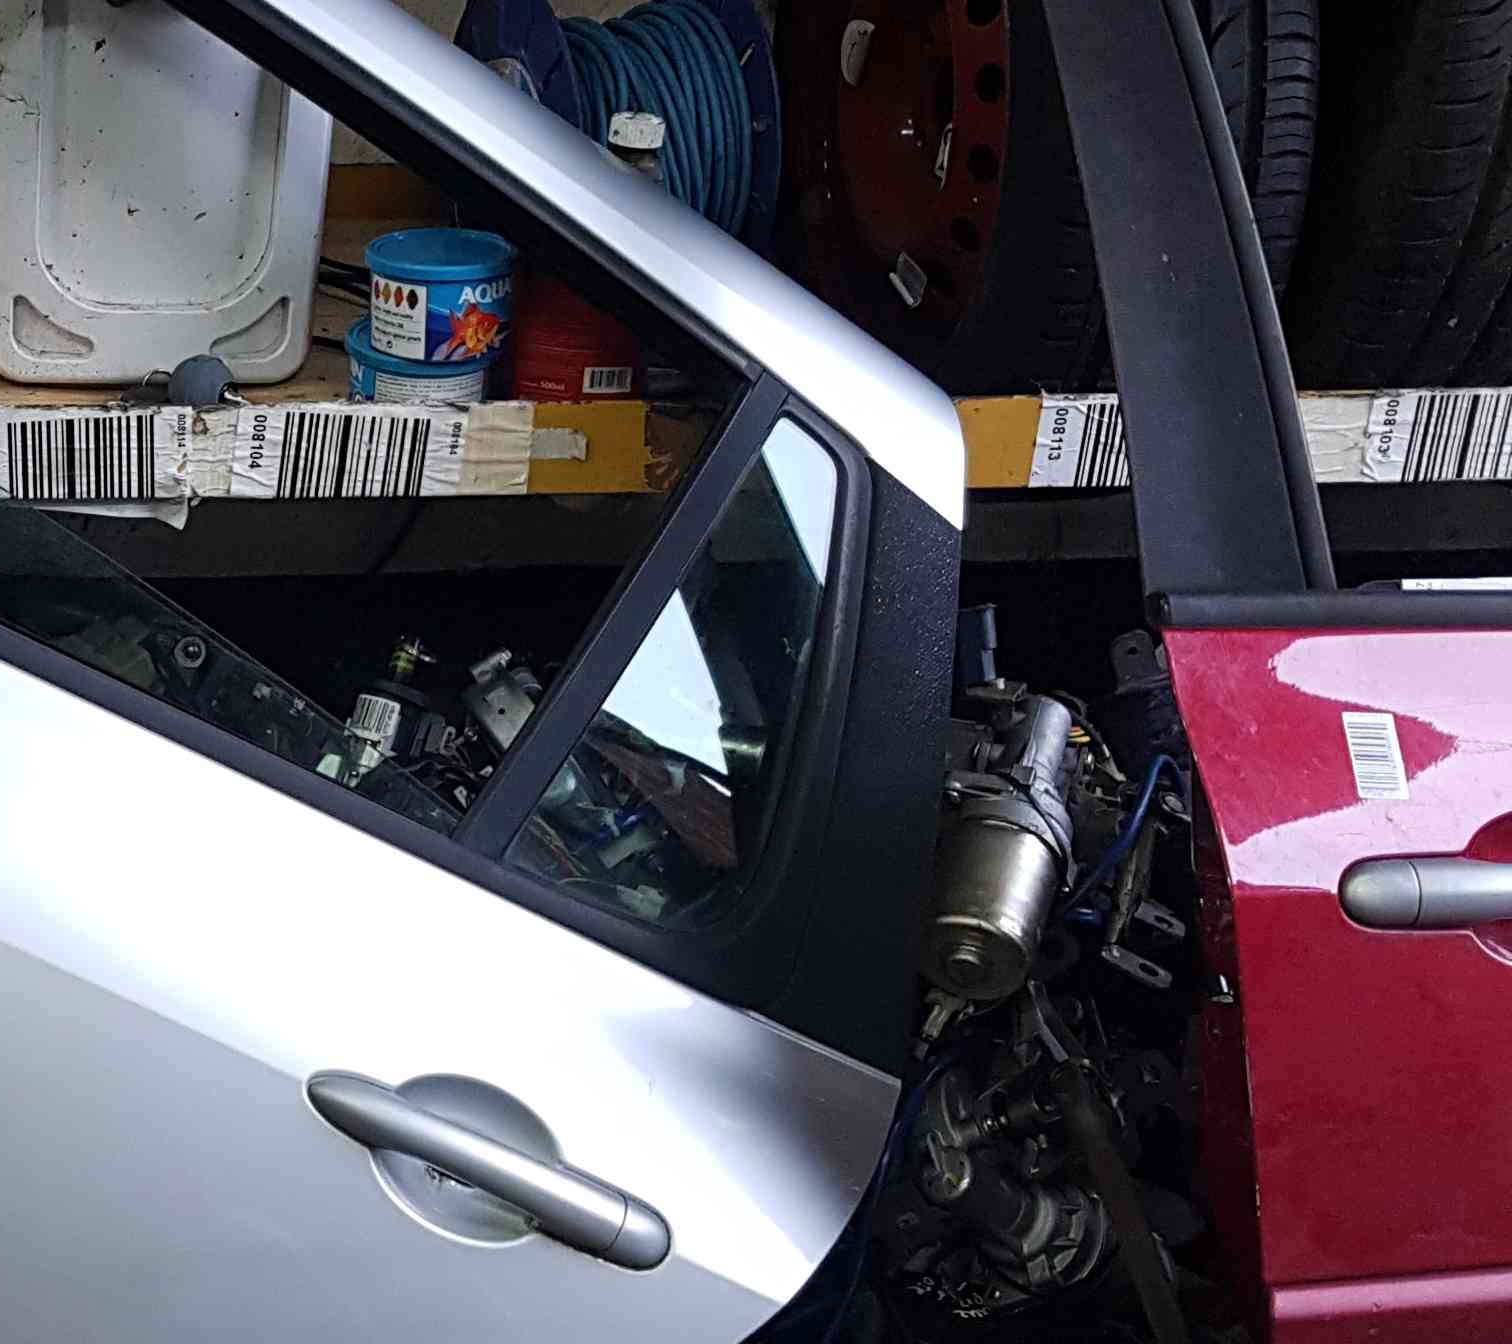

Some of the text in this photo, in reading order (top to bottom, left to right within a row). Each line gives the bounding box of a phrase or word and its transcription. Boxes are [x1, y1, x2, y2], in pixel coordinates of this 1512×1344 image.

[248, 414, 268, 470] 008104
[1048, 407, 1069, 462] 008113
[1378, 399, 1400, 458] 008103
